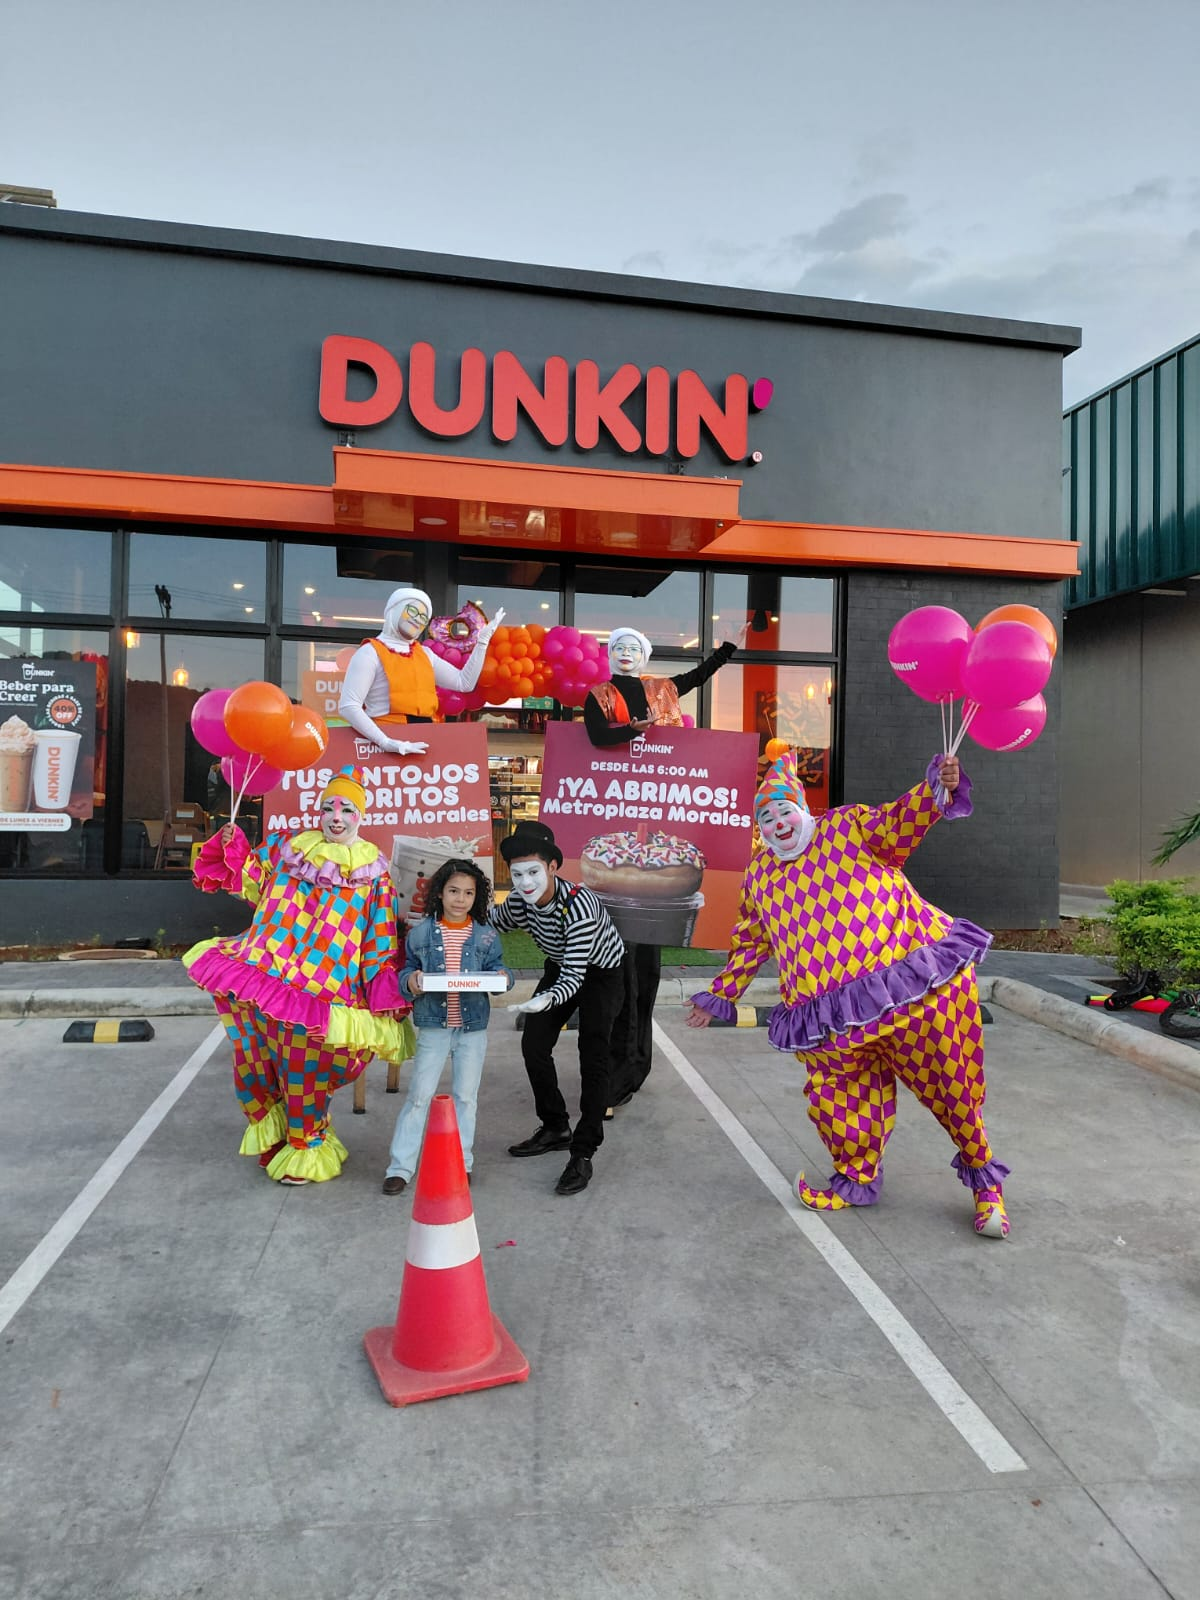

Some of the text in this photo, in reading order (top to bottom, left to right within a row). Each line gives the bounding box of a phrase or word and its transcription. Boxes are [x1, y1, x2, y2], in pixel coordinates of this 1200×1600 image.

[319, 334, 773, 461] DUNKIN'
[0, 680, 74, 694] Beber para
[0, 691, 37, 702] Creer
[633, 743, 674, 754] DUNKIN'
[48, 747, 60, 802] DUNKIN'
[282, 768, 333, 791] TUS
[362, 763, 480, 787] NTOJOS
[591, 761, 708, 778] DESDE LAS 6:00 AM
[299, 785, 459, 812] FORITOS
[558, 777, 738, 809] ¡YA ABRIMOS!
[267, 806, 489, 830] Metraza Morales
[543, 798, 751, 828] Metroplaza Morales
